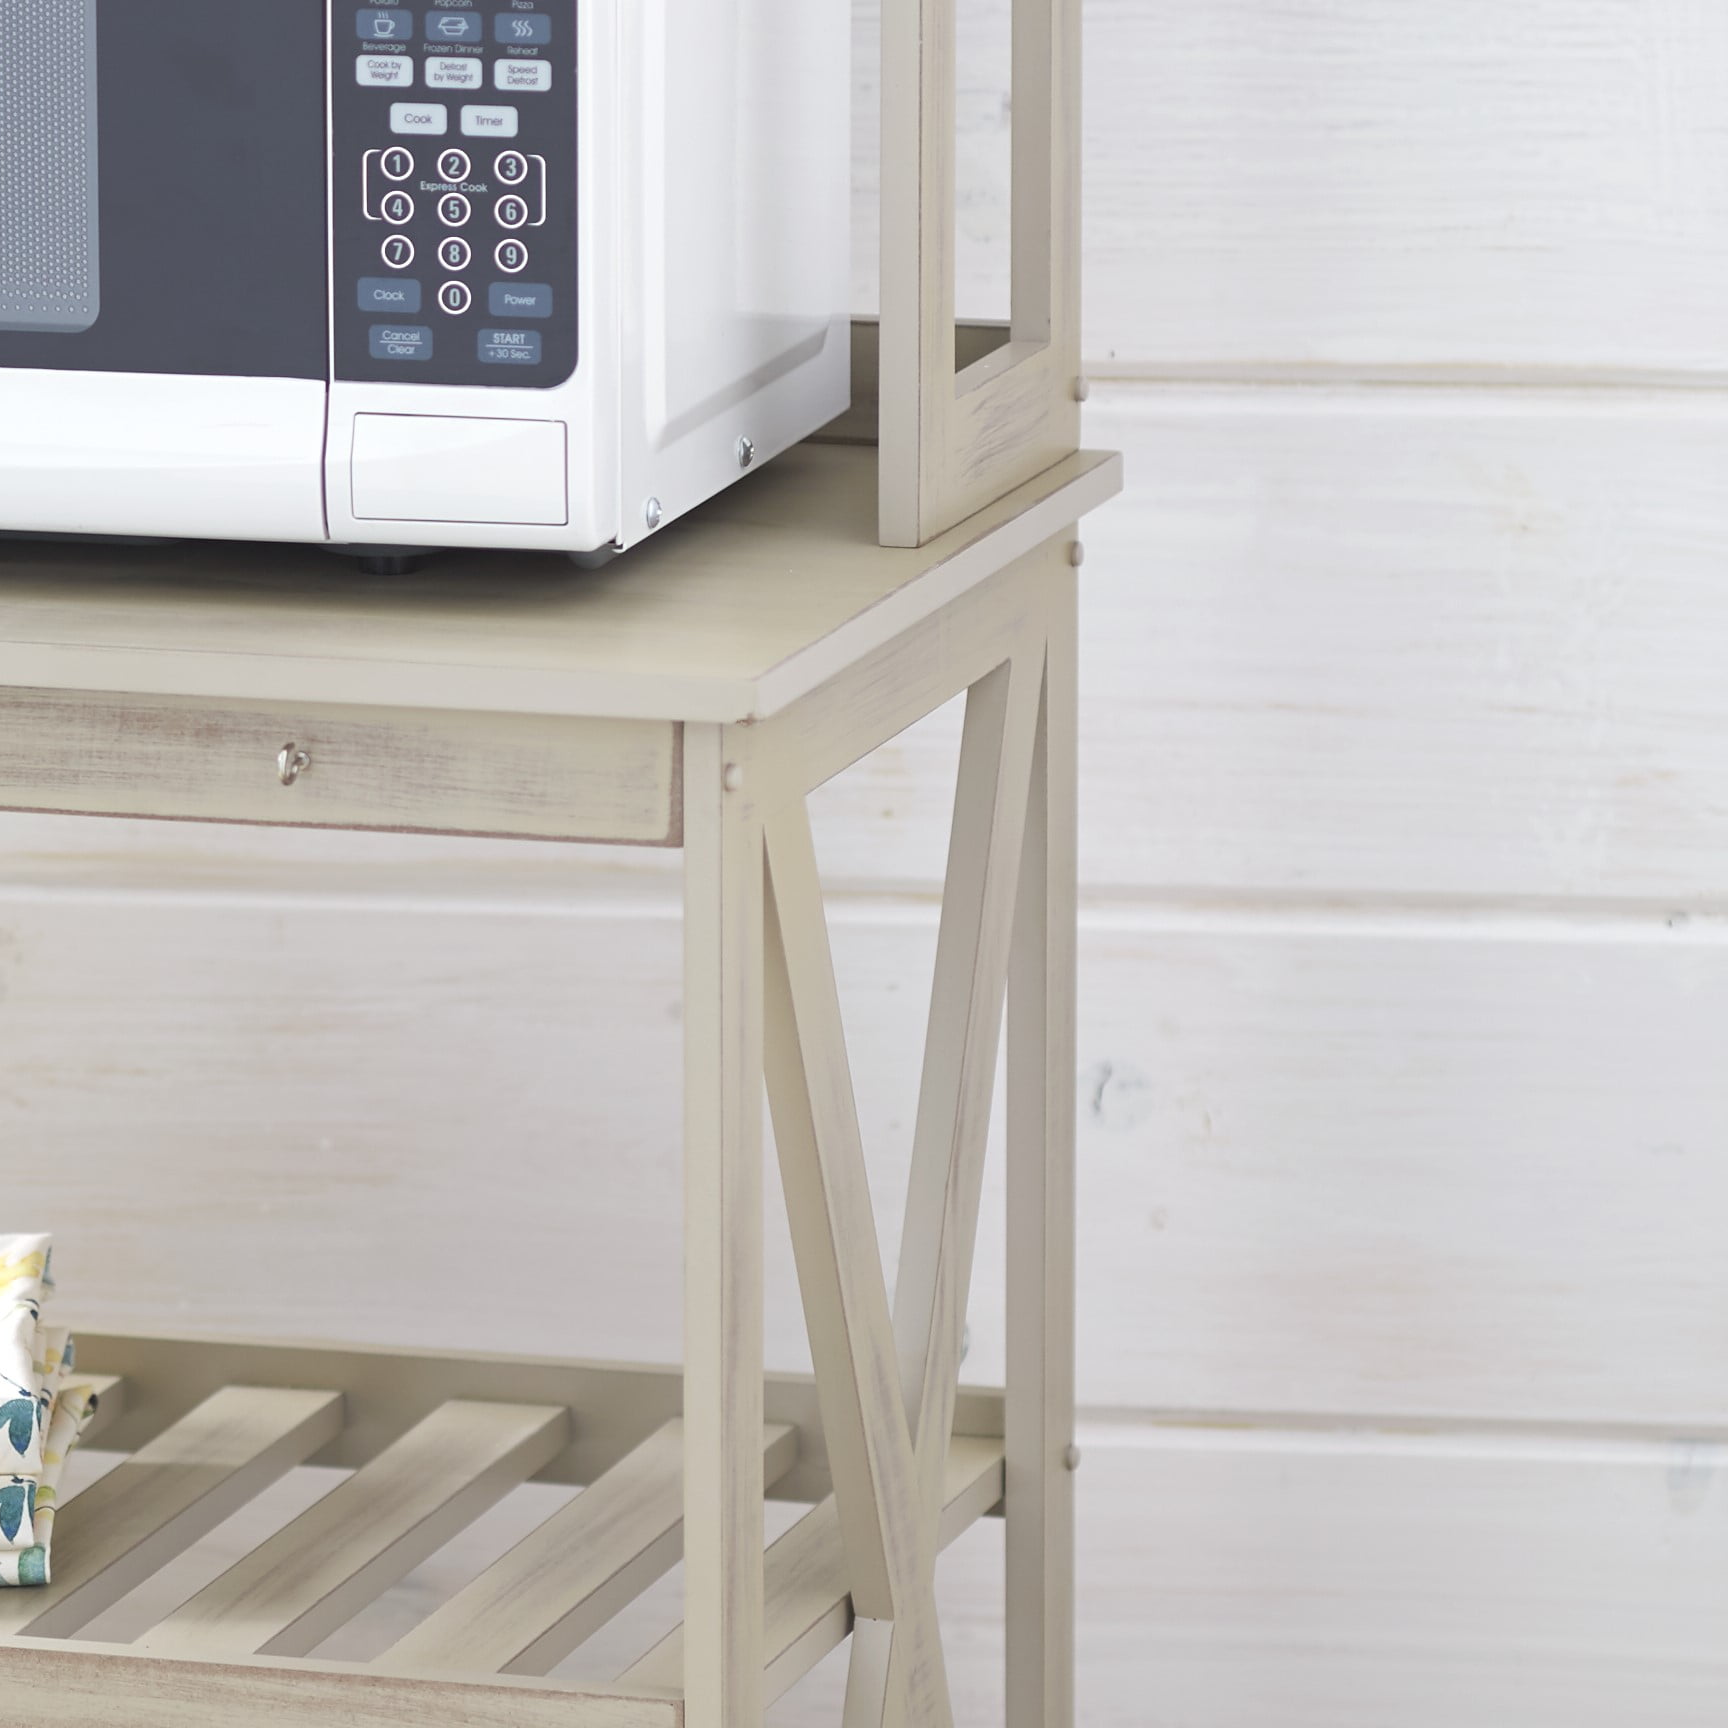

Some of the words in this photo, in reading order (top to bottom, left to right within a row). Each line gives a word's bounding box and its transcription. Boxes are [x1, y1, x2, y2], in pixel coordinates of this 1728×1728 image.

[512, 0, 534, 9] Pizza
[362, 42, 406, 53] Beverage
[423, 44, 453, 53] Frozen
[456, 45, 484, 54] Dinner
[507, 46, 538, 55] Reheat
[367, 60, 390, 69] Cook
[391, 61, 401, 71] by
[440, 62, 467, 71] Defrost
[508, 65, 538, 76] Speed
[370, 70, 398, 80] Weight
[433, 72, 444, 82] by
[446, 72, 473, 82] Weight
[507, 76, 539, 86] Defrost
[404, 113, 432, 124] Cook
[476, 116, 503, 126] Timer
[393, 154, 401, 172] 1
[449, 156, 460, 175] 2
[506, 158, 516, 176] 3
[420, 181, 457, 192] Express
[460, 182, 488, 192] Cook
[392, 199, 403, 216] 4
[449, 200, 460, 218] 5
[506, 202, 516, 220] 6
[393, 242, 403, 260] 7
[449, 245, 460, 262] 8
[506, 246, 517, 264] 9
[374, 289, 404, 301] Clock
[449, 288, 460, 306] 0
[504, 294, 536, 305] Power
[382, 330, 420, 341] Cancel
[493, 333, 525, 344] START
[387, 344, 415, 354] Clear
[510, 349, 530, 359] Sec.
